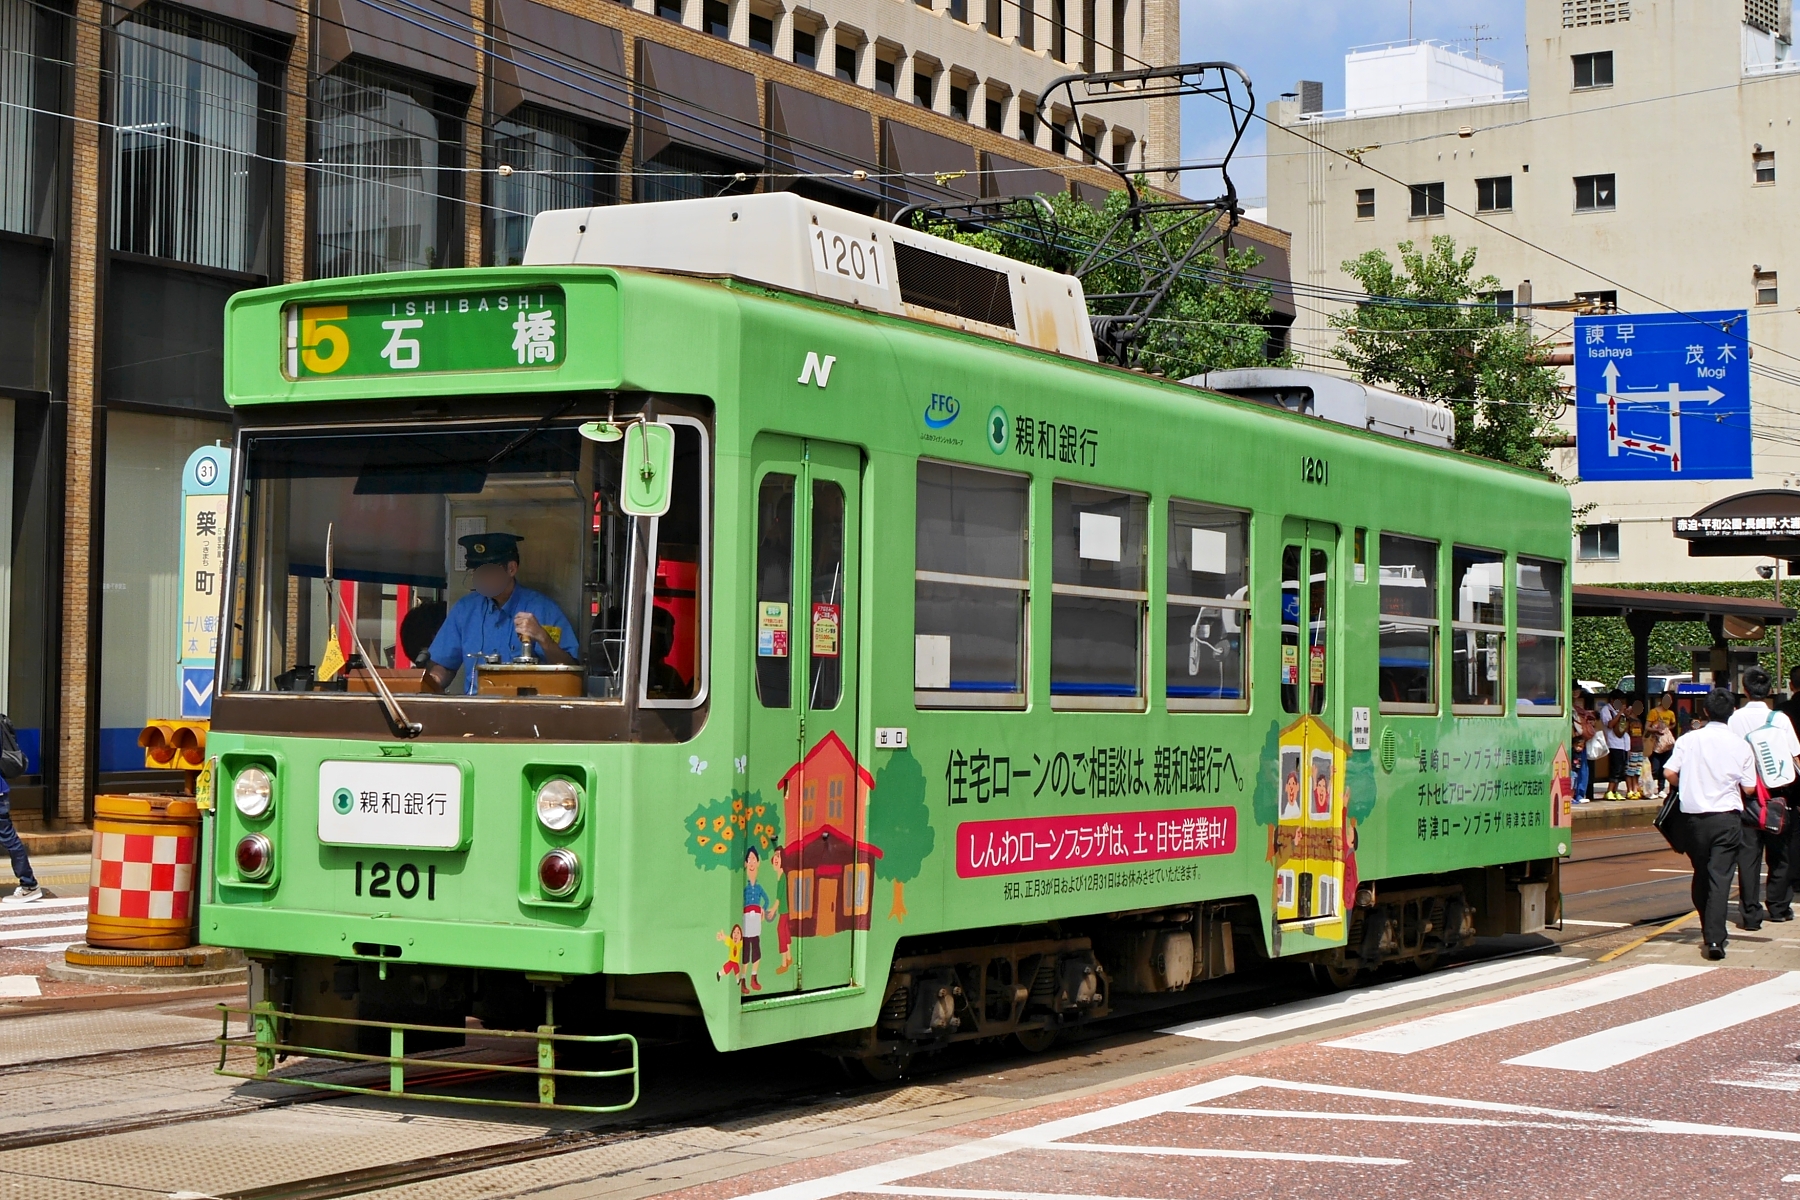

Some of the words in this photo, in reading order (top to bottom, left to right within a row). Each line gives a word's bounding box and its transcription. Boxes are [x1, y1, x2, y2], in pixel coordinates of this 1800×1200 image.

[816, 230, 880, 285] 1201
[391, 294, 544, 317] ISHIBASHI
[301, 305, 350, 374] 5
[380, 309, 556, 369] 石橋
[1585, 323, 1636, 345] 諫早
[1588, 346, 1633, 359] Isahaya
[1685, 343, 1737, 366] 茂木
[797, 351, 836, 388] N
[1697, 366, 1726, 379] Mogi
[931, 393, 954, 413] FFG
[1423, 402, 1453, 433] 1201
[1015, 415, 1098, 467] 親和銀行
[201, 465, 213, 477] 31
[1301, 455, 1329, 486] 1201
[196, 511, 216, 595] 築町
[1355, 711, 1368, 721] 入口
[880, 730, 904, 745] 出口
[1757, 741, 1777, 775] PUMA
[945, 745, 1244, 807] 住宅ローンのご相談は、親和銀行へ。
[359, 790, 447, 816] 親和銀行
[970, 815, 1228, 869] しんわローンプラザは、土・日も営業中!
[355, 861, 436, 901] 1201
[1003, 864, 1201, 901] 祝日、正月3が日および12月31日はお休みさせていただきます。
